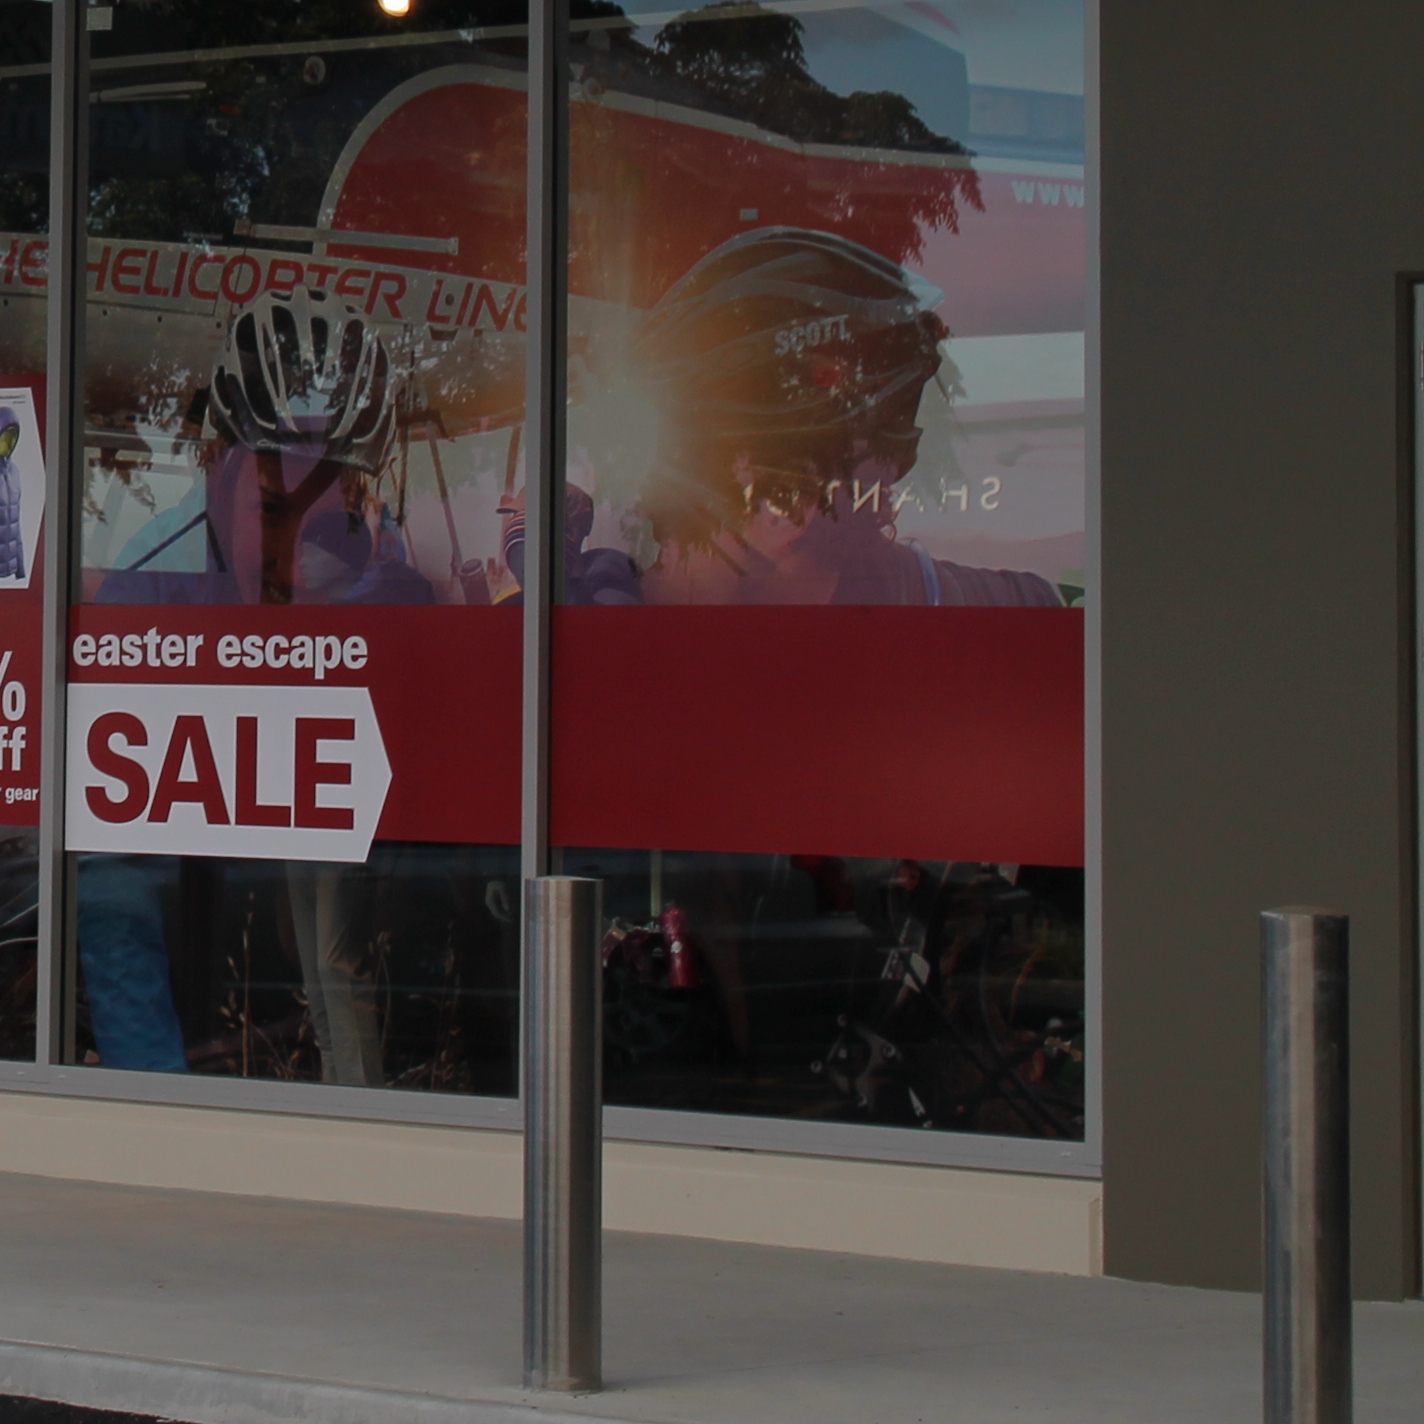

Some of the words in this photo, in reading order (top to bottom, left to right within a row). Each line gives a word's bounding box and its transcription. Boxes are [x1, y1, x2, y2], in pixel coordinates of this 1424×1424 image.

[73, 627, 203, 668] easter
[216, 634, 368, 680] escape
[5, 786, 39, 804] gear
[85, 711, 356, 831] SALE
